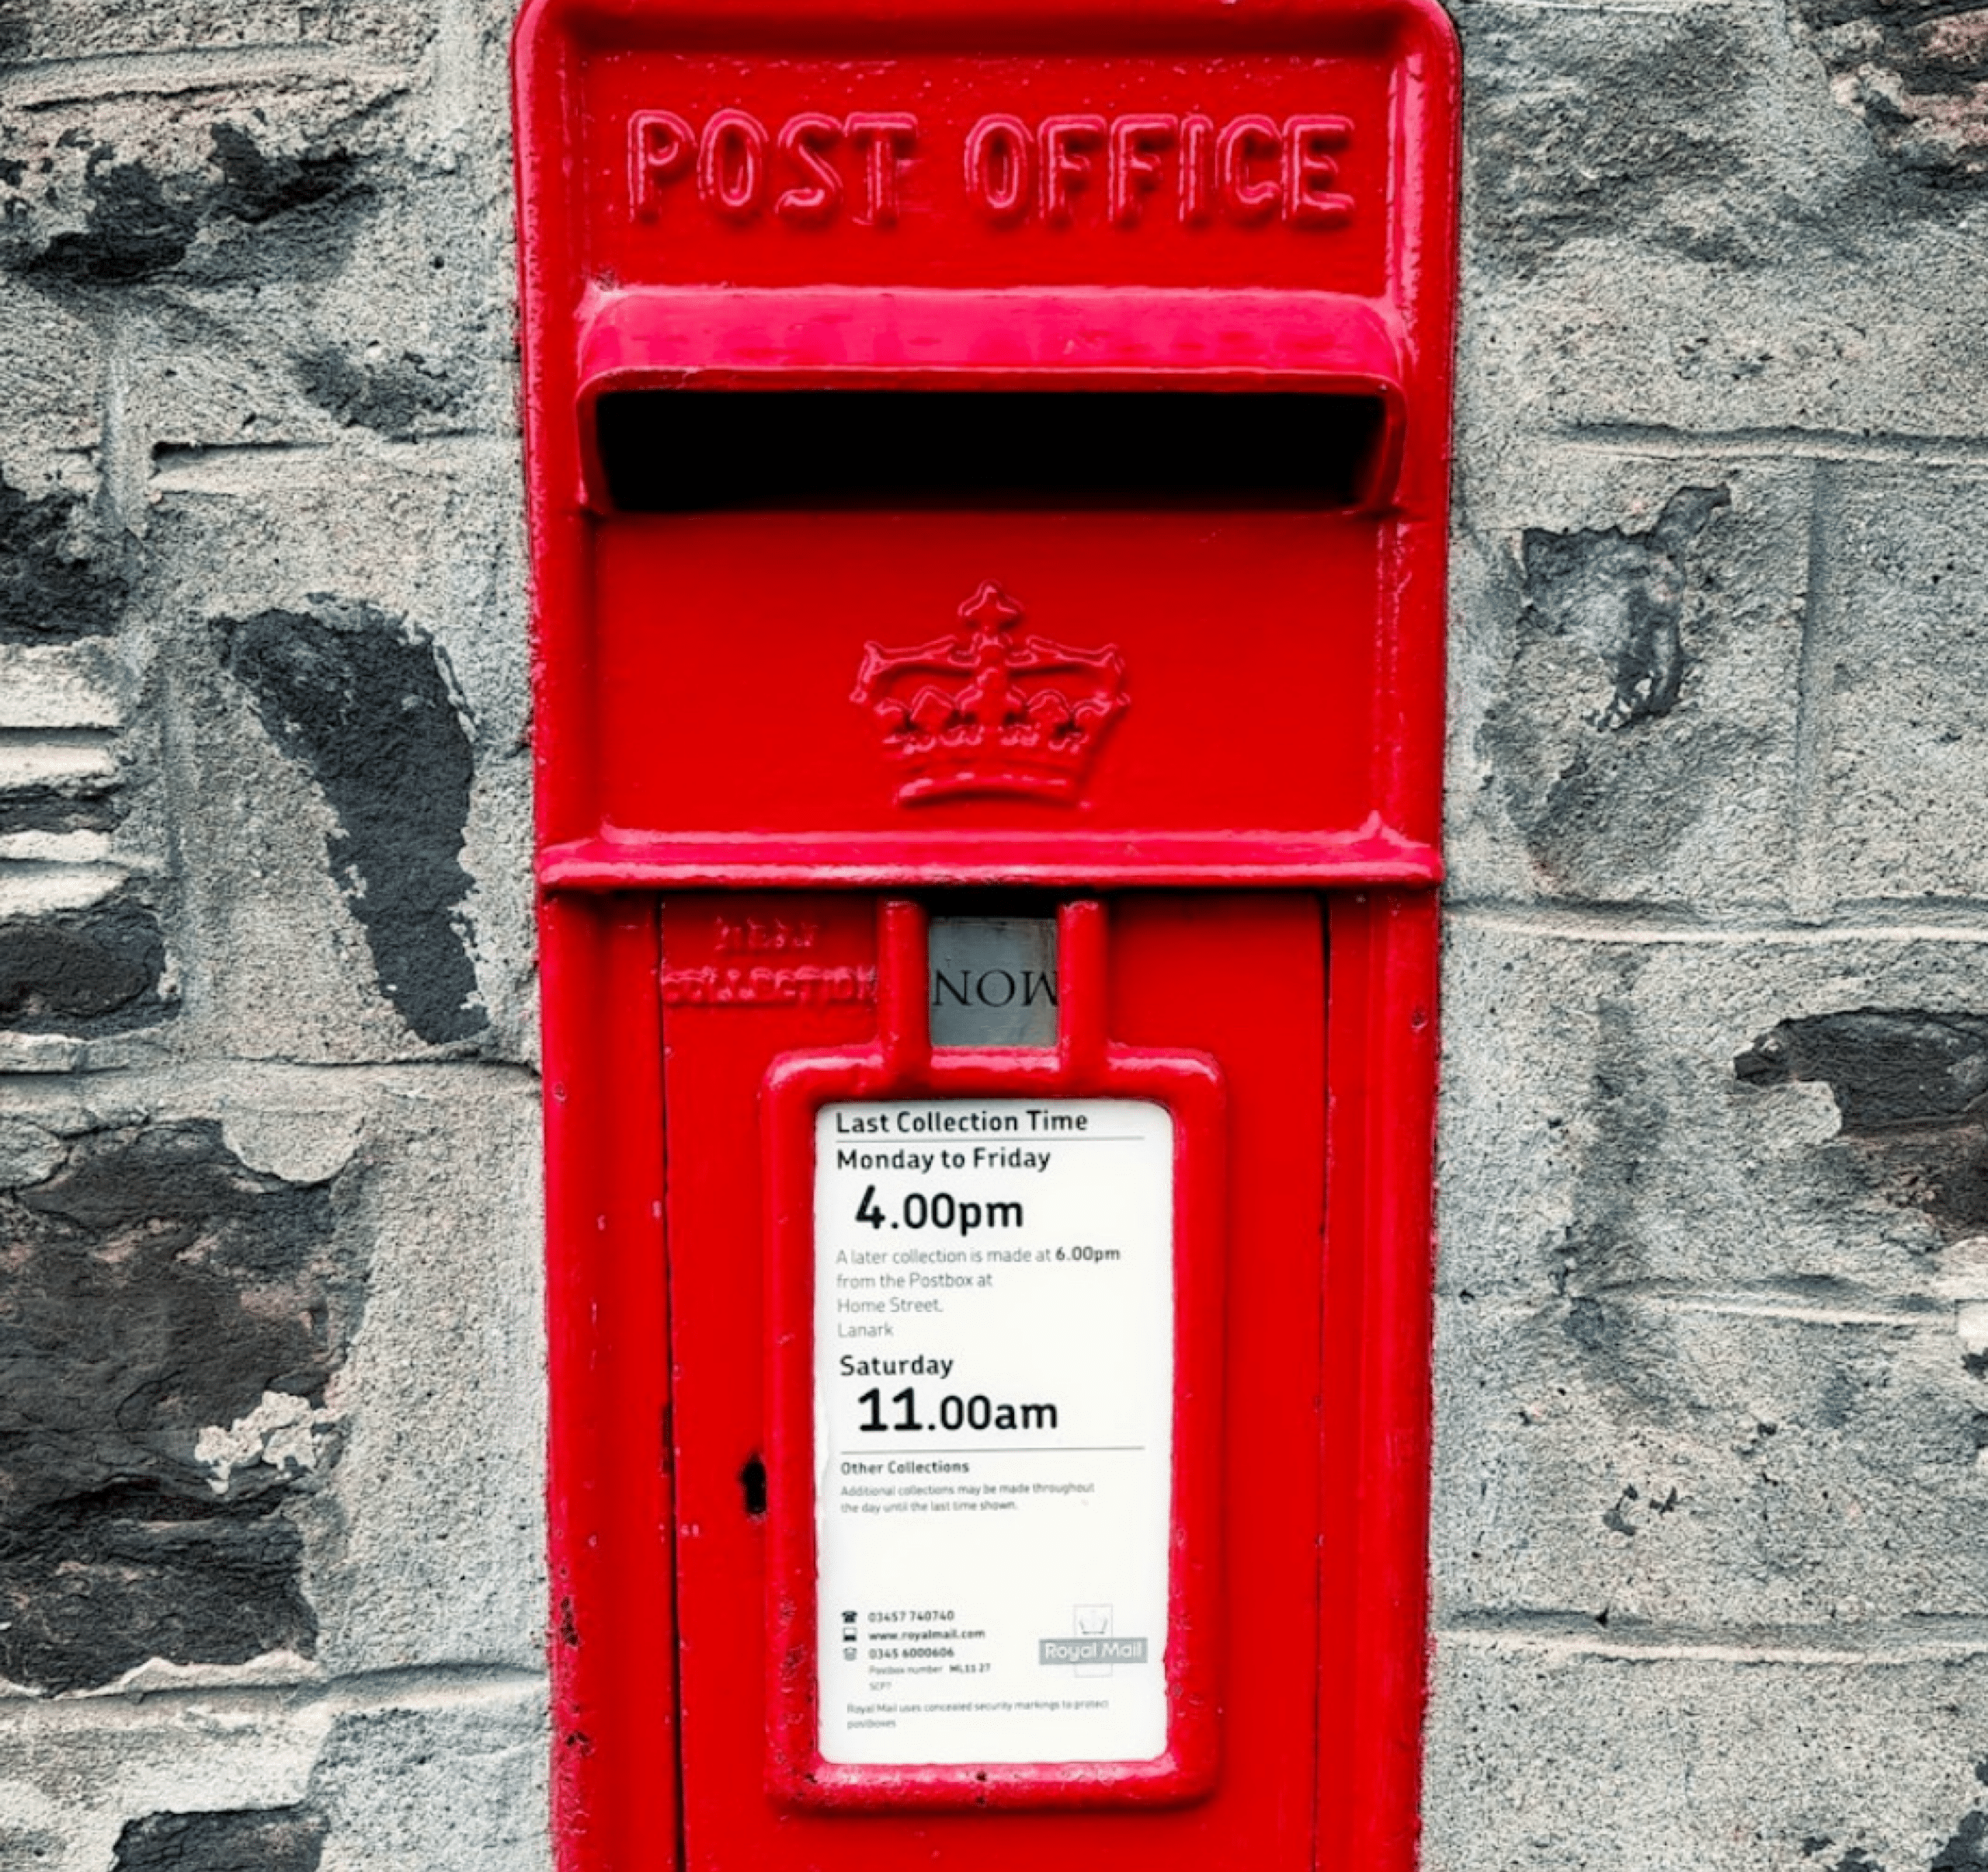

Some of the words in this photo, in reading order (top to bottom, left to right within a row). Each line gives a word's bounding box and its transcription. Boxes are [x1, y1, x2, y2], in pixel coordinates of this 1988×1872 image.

[627, 108, 918, 228] POST
[964, 113, 1356, 229] OFFICE
[836, 1112, 890, 1133] Last
[896, 1111, 1018, 1133] Collection
[1026, 1109, 1088, 1131] Time
[836, 1149, 934, 1174] Monday
[941, 1150, 965, 1169] to
[973, 1147, 1051, 1172] Friday
[855, 1184, 1024, 1237] 4.00pm
[836, 1250, 847, 1265] A
[851, 1250, 887, 1264] later
[893, 1248, 967, 1263] collection
[971, 1248, 982, 1262] is
[986, 1247, 1032, 1262] made
[1034, 1248, 1052, 1261] at
[1055, 1246, 1121, 1263] 6.00pm
[836, 1274, 876, 1289] from
[880, 1274, 905, 1288] the
[909, 1272, 973, 1288] Postbox
[977, 1273, 993, 1288] at
[837, 1298, 885, 1313] Home
[838, 1322, 894, 1338] Lanark
[839, 1354, 954, 1380] Saturday
[857, 1387, 1058, 1432] 11.00am
[840, 1461, 883, 1475] Other
[888, 1460, 970, 1474] Collections
[867, 1611, 907, 1623] 03457
[909, 1609, 955, 1622] 740740
[868, 1629, 985, 1642] www.royalmail.com
[1045, 1642, 1097, 1661] Royal
[1102, 1641, 1142, 1658] Mail
